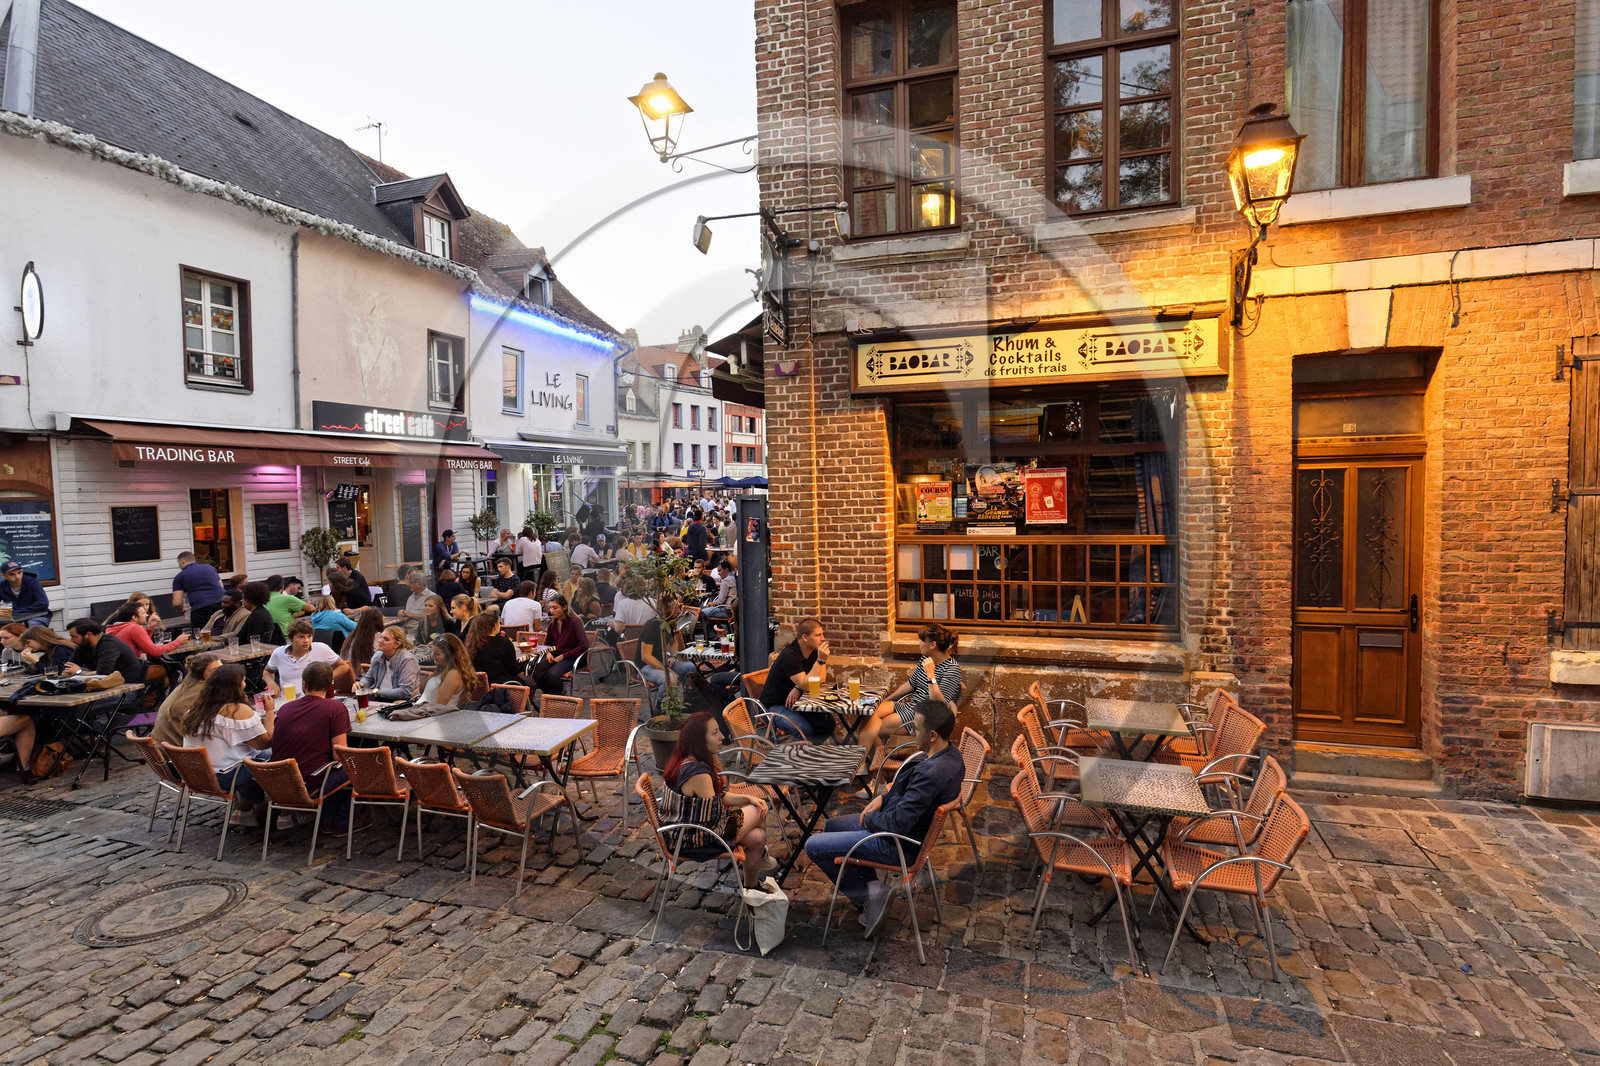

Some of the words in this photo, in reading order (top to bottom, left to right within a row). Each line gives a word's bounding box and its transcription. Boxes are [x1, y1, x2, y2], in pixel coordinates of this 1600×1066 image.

[993, 336, 1040, 353] Rhum
[1044, 337, 1056, 348] &
[1106, 337, 1176, 356] BAOBAR
[889, 352, 950, 371] BAOBAR
[989, 349, 1062, 366] Cocktails
[984, 366, 996, 377] de
[999, 364, 1034, 376] fruits
[1038, 362, 1068, 375] frais
[546, 372, 562, 388] LE
[531, 390, 573, 411] LIVING
[364, 409, 406, 435] street
[407, 414, 435, 437] café
[134, 446, 204, 462] TRADING
[208, 450, 236, 462] BAR
[334, 456, 357, 465] STREET
[552, 455, 562, 464] LE
[563, 455, 584, 464] LIVING
[446, 460, 478, 470] TRADING
[480, 461, 493, 470] BAR
